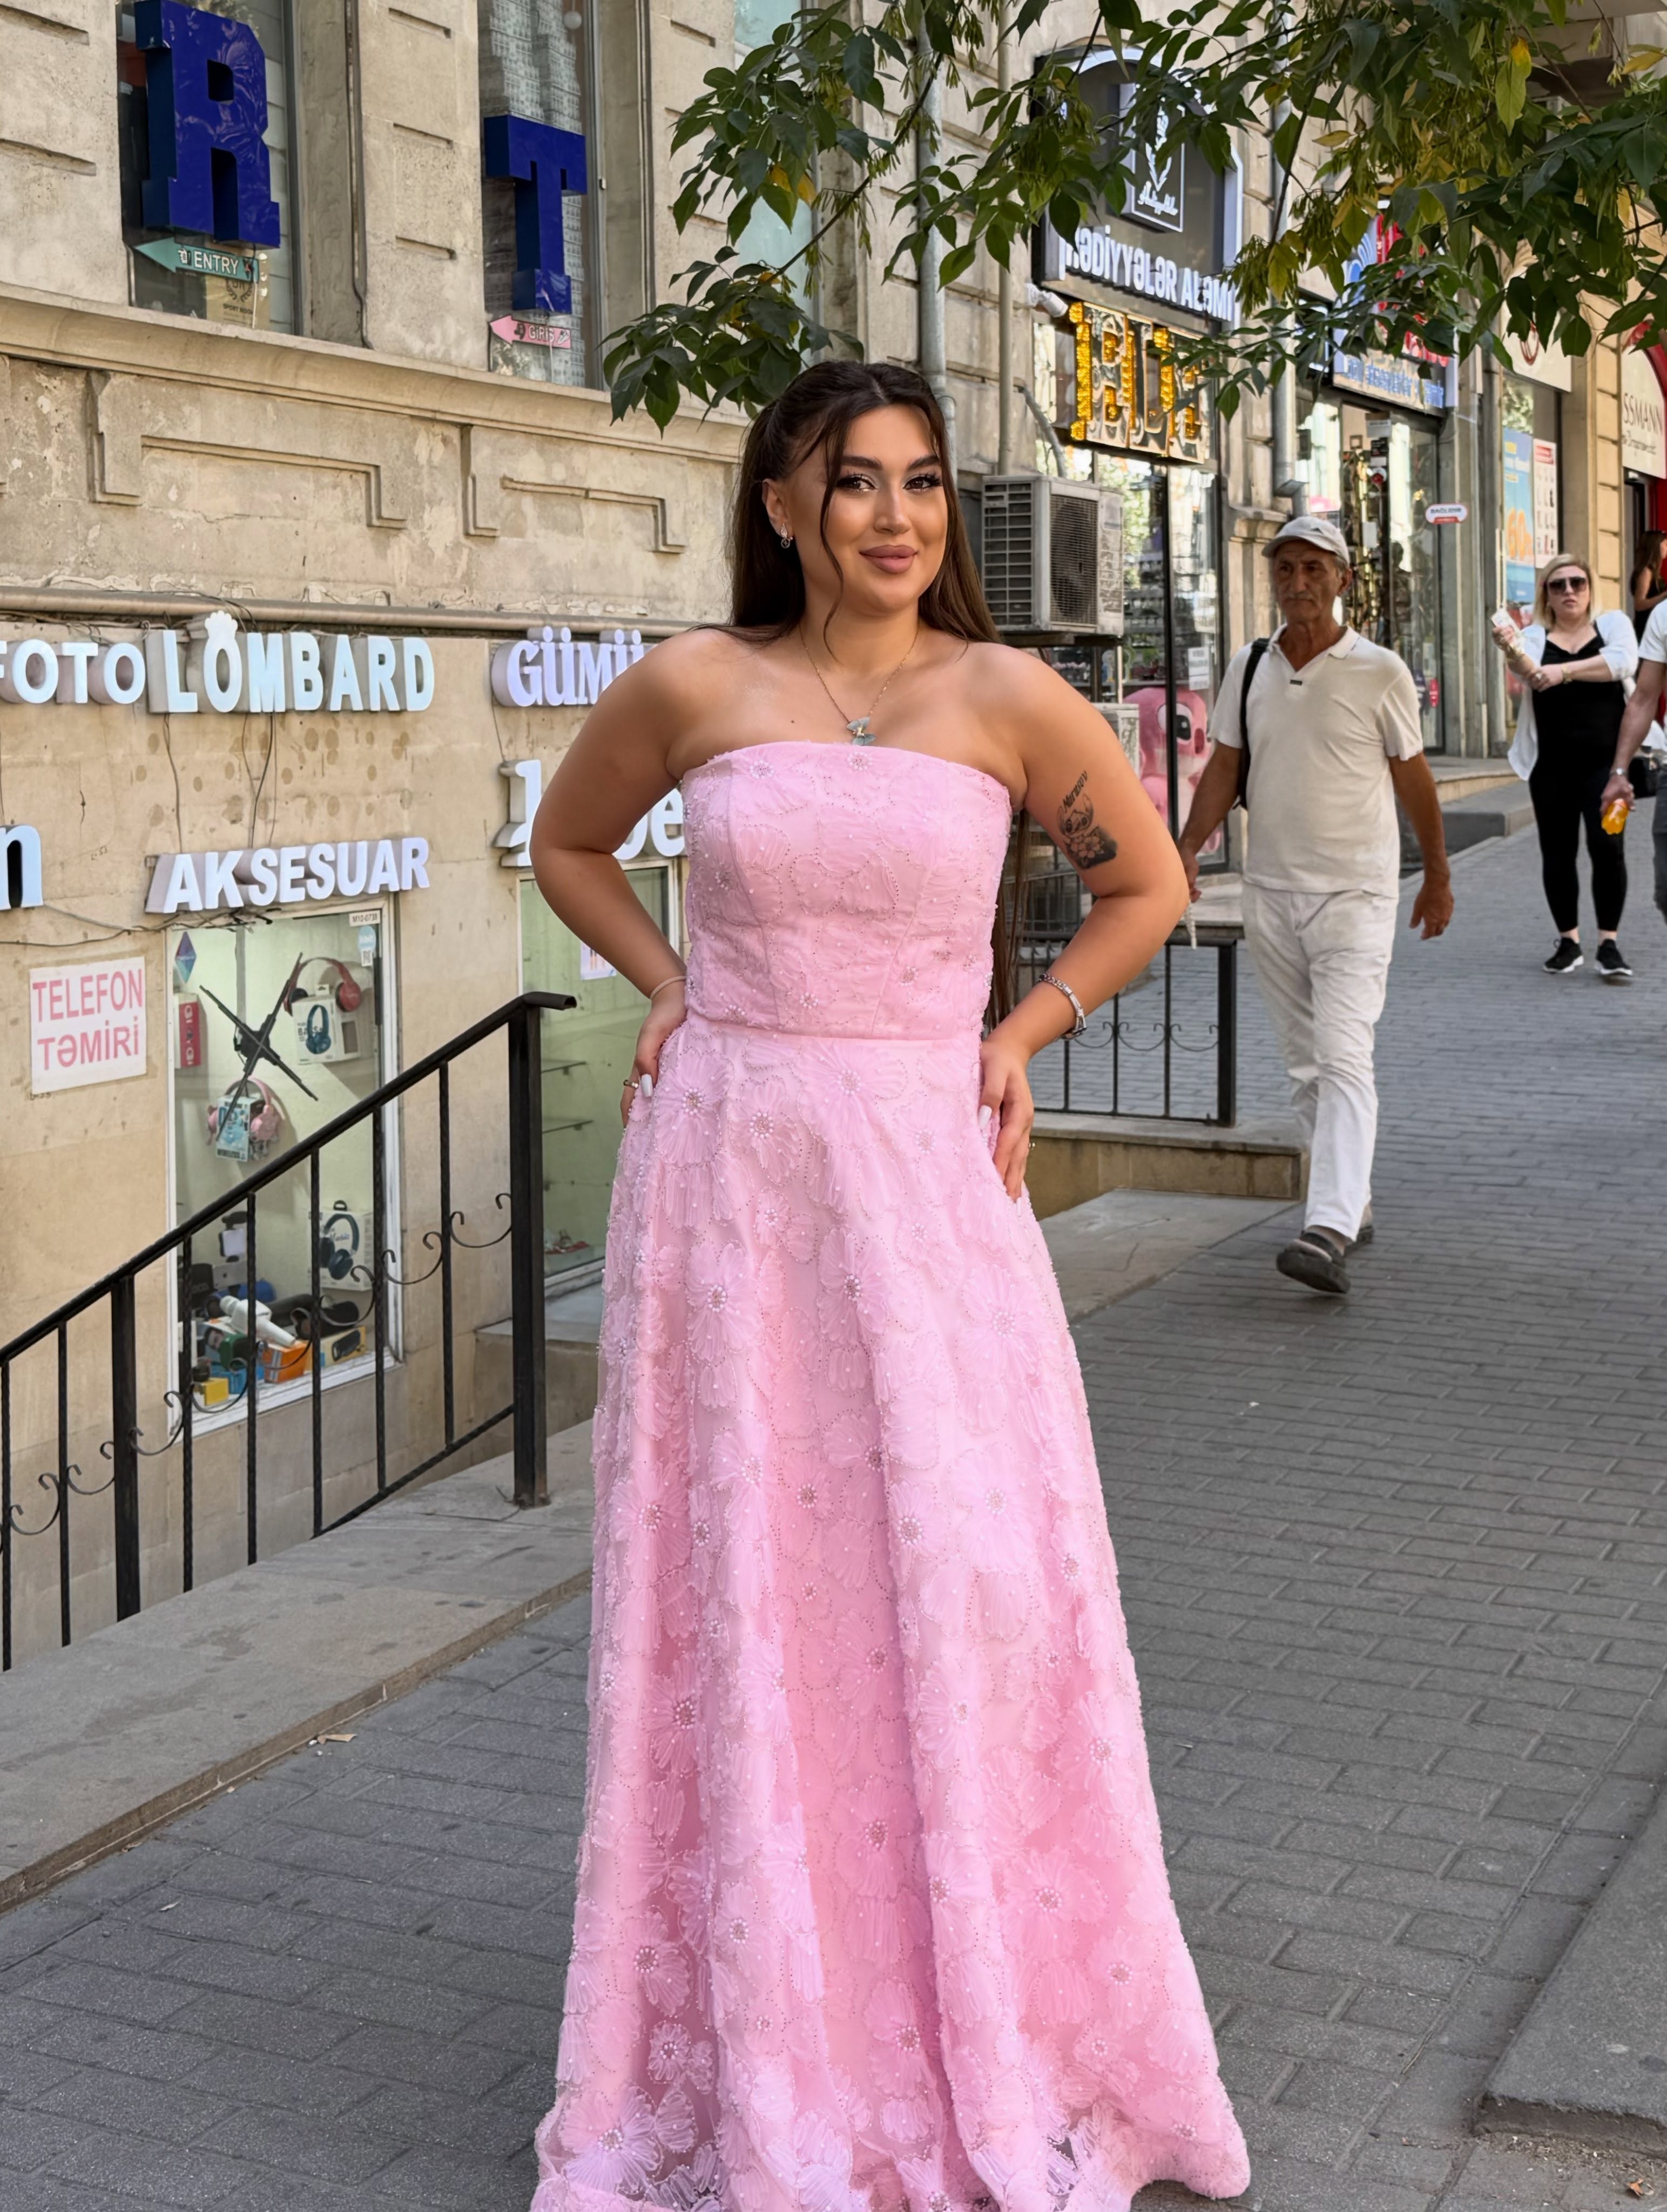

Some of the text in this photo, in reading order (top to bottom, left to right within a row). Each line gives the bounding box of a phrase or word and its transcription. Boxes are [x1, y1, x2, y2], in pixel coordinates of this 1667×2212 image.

[194, 251, 238, 275] ENTRY
[0, 610, 435, 713] OTO LOMBARD
[163, 837, 430, 913] AKSESUAR
[32, 968, 142, 1022] TELEFON
[37, 1015, 139, 1070] TƏMİRİ
